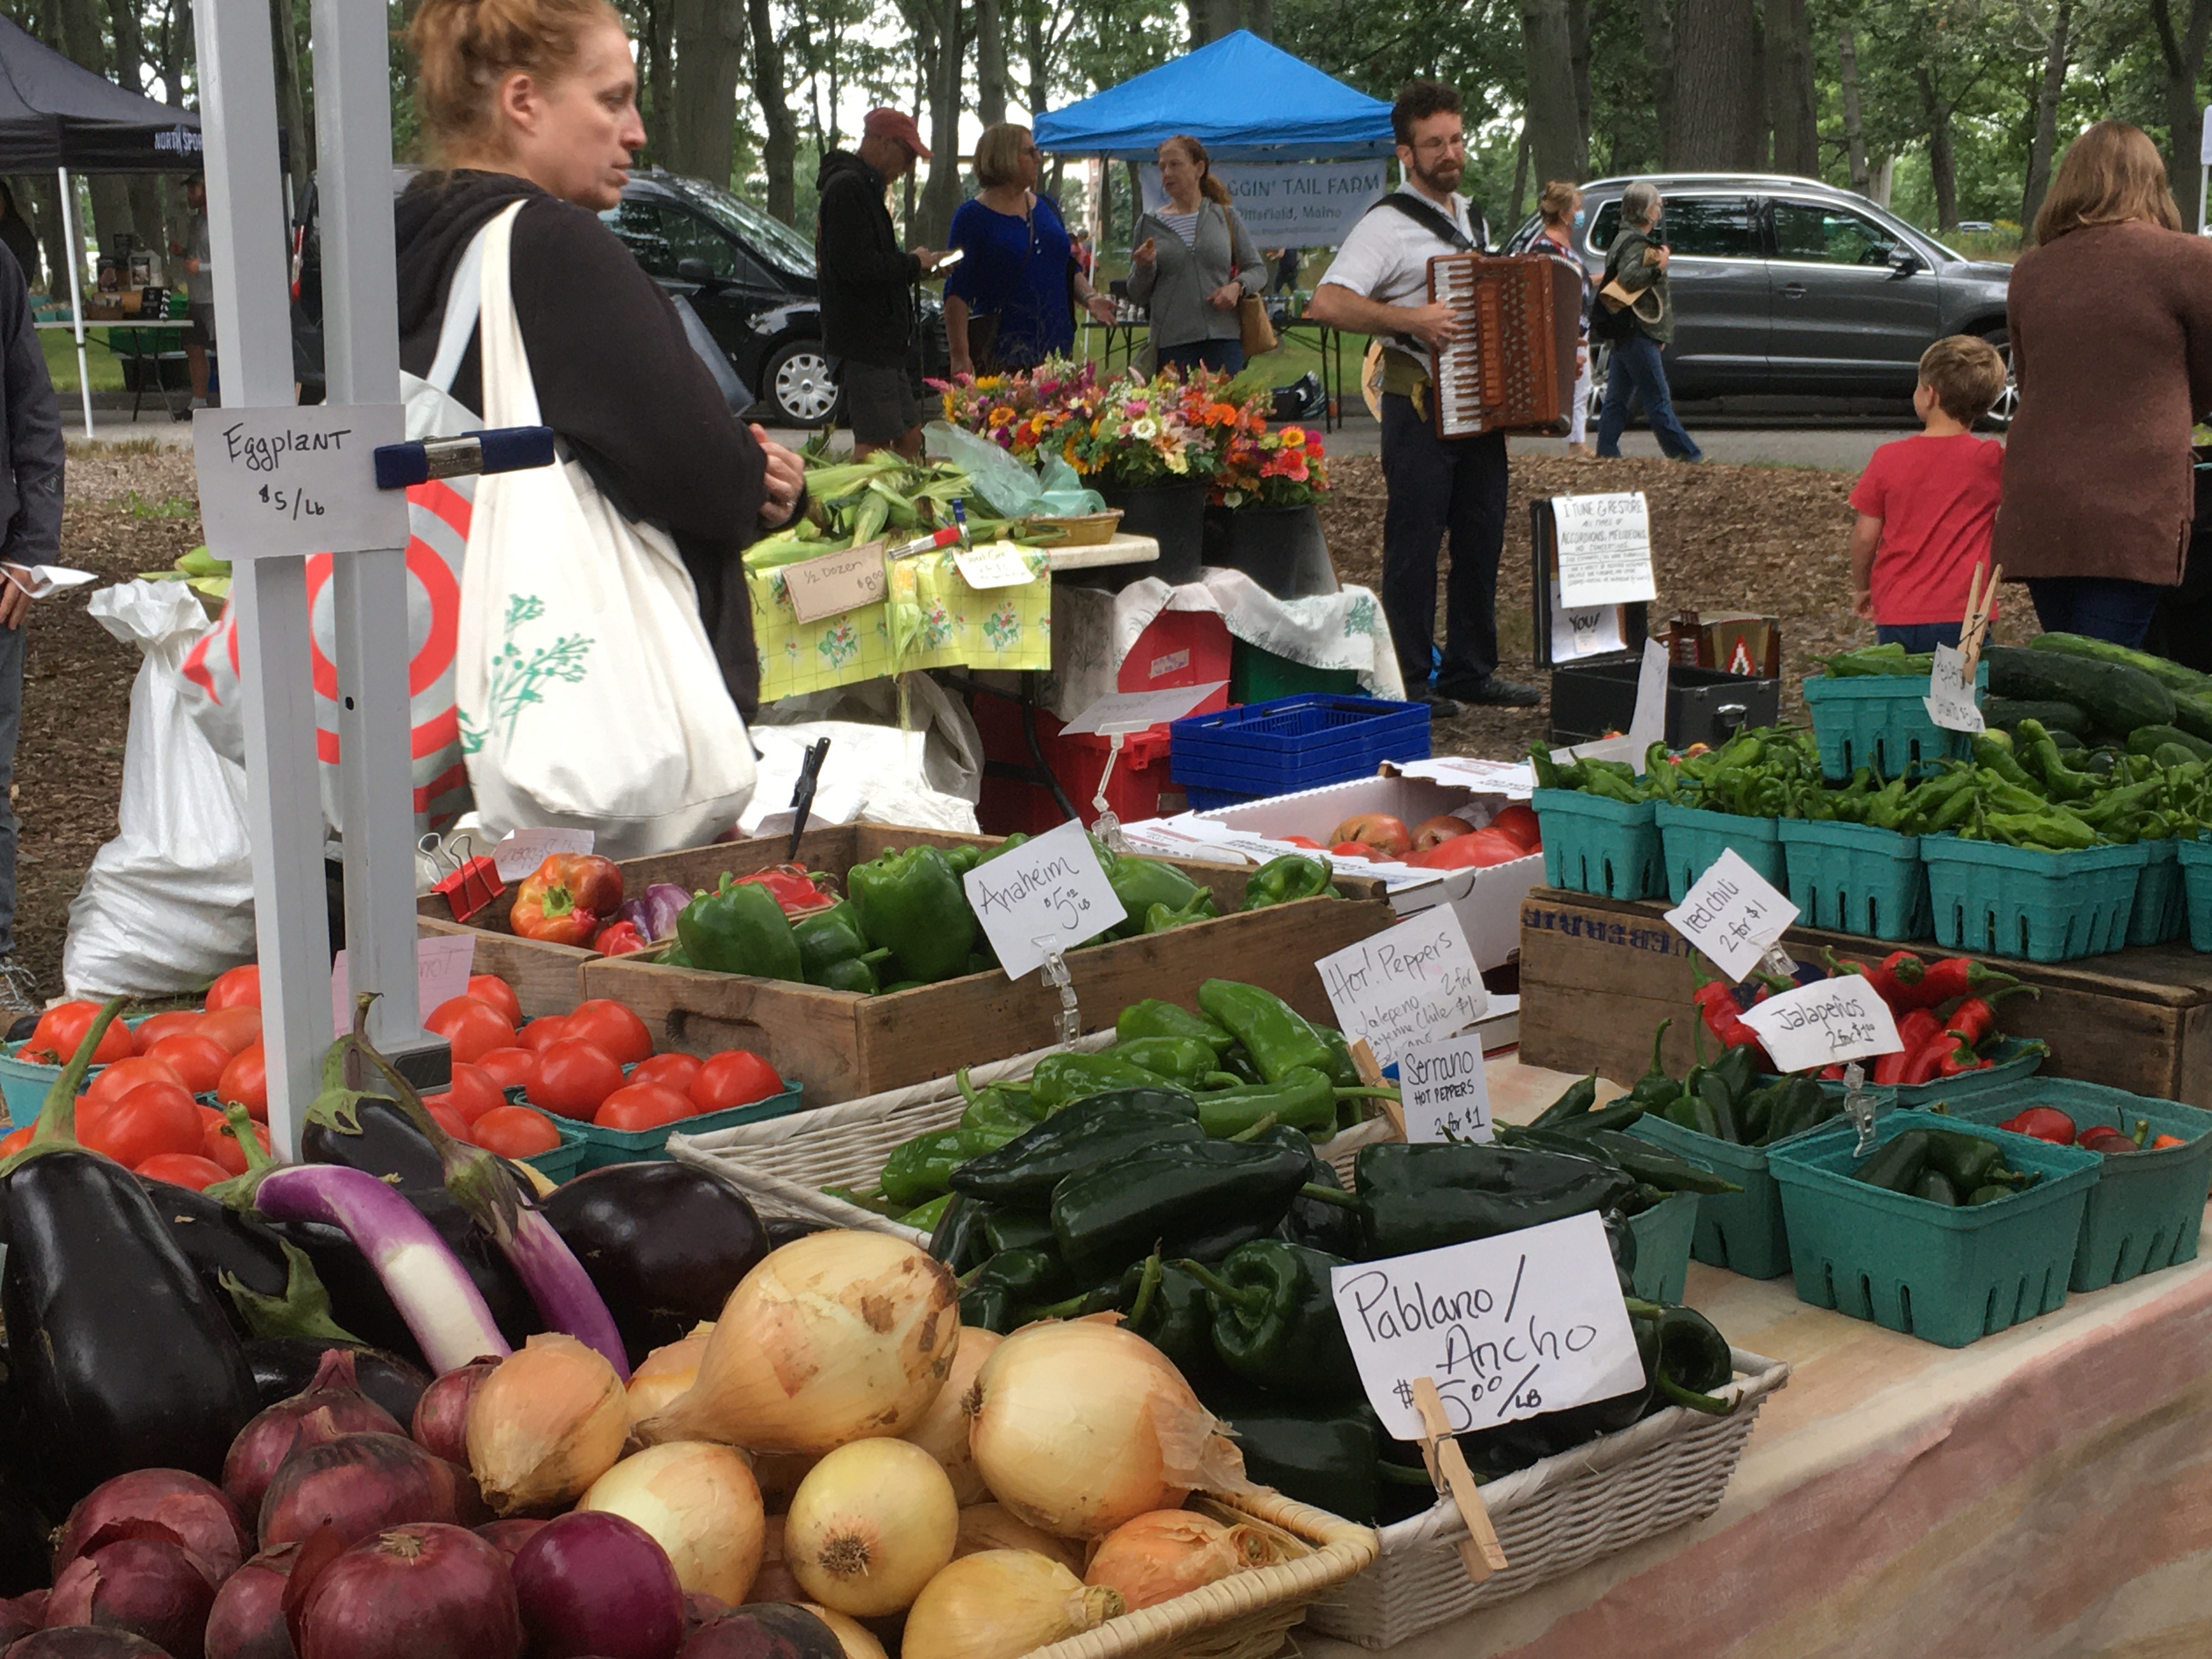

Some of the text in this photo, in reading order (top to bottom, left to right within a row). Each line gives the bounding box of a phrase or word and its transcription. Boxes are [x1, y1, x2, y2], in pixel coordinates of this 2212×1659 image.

[155, 132, 202, 151] NORTH SPOR
[1228, 174, 1379, 196] GGIN' TAIL FARM
[1302, 206, 1342, 218] Maine
[1564, 504, 1570, 517] I
[1572, 501, 1594, 517] TUNE
[1607, 499, 1643, 515] RESTORE
[1568, 612, 1601, 633] YOU!
[979, 856, 1080, 915] Anaheim
[1683, 902, 1716, 934] red
[1719, 935, 1739, 953] 2
[1732, 918, 1752, 939] for
[1378, 932, 1452, 980] Peppers
[1441, 967, 1472, 996] 2 for
[1416, 1002, 1454, 1029] Chile
[1825, 1030, 1844, 1048] 2
[1837, 1029, 1860, 1045] for
[1405, 1051, 1474, 1085] Serrano
[1414, 1079, 1475, 1107] HOT PEPPERS
[1434, 1117, 1444, 1136] 2
[1448, 1111, 1462, 1132] for
[1436, 1314, 1597, 1379] Ancho
